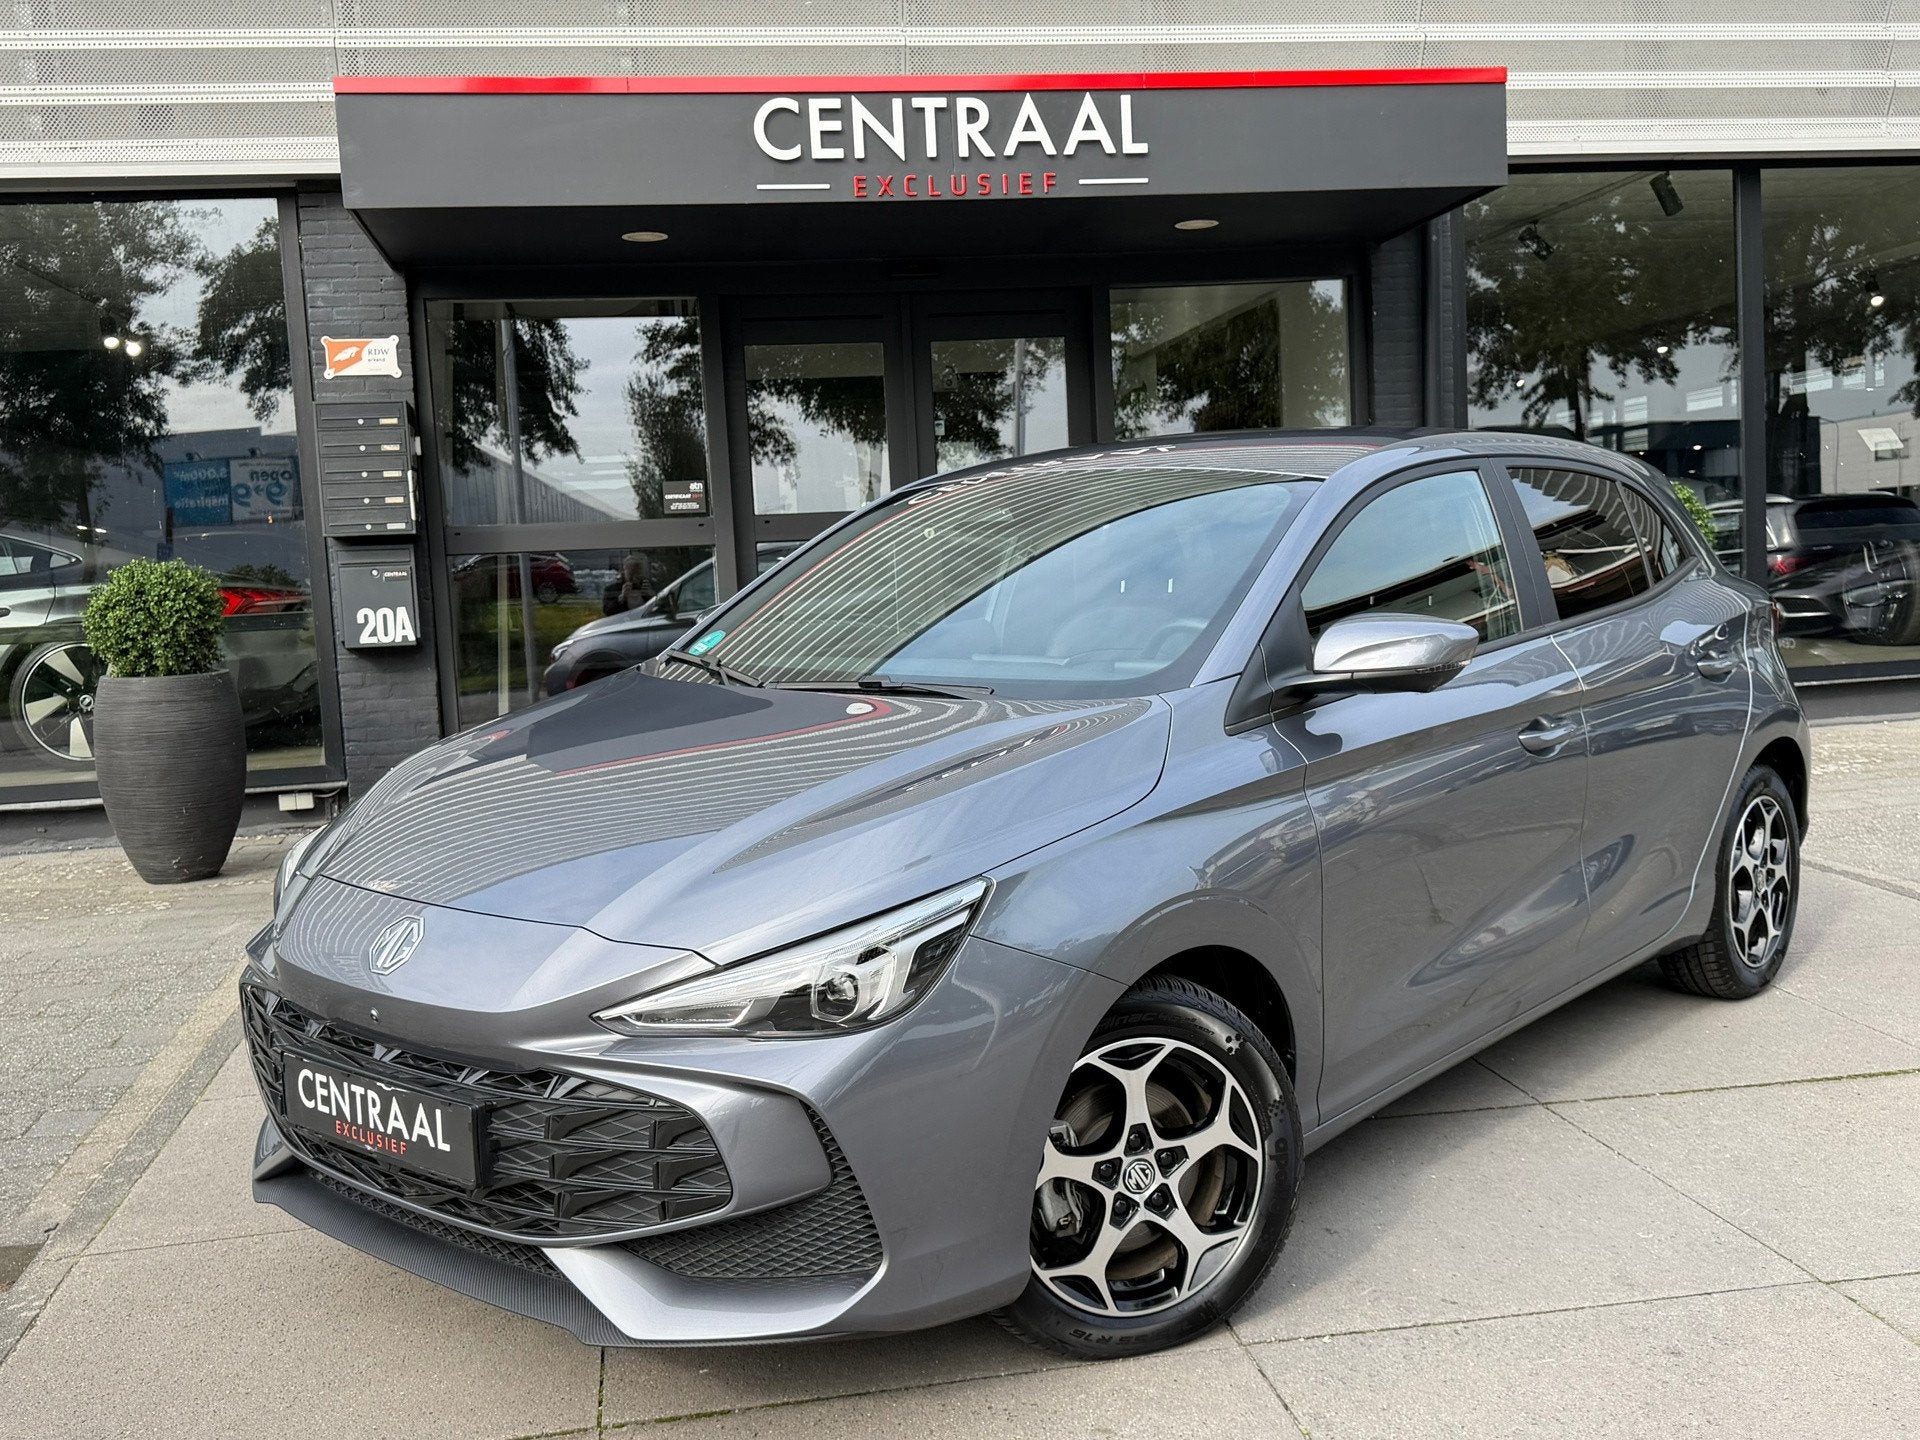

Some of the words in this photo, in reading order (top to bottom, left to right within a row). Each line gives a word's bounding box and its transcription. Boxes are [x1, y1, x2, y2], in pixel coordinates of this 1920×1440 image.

[753, 91, 1149, 162] CENTRAAL
[853, 171, 1057, 198] EXCLUSIEF
[367, 348, 389, 356] RDW
[356, 606, 416, 645] 20A
[371, 918, 421, 970] MG
[298, 1068, 450, 1152] CENTRAAL
[335, 1119, 407, 1155] EXCLUSIEF
[1127, 1163, 1152, 1191] MG
